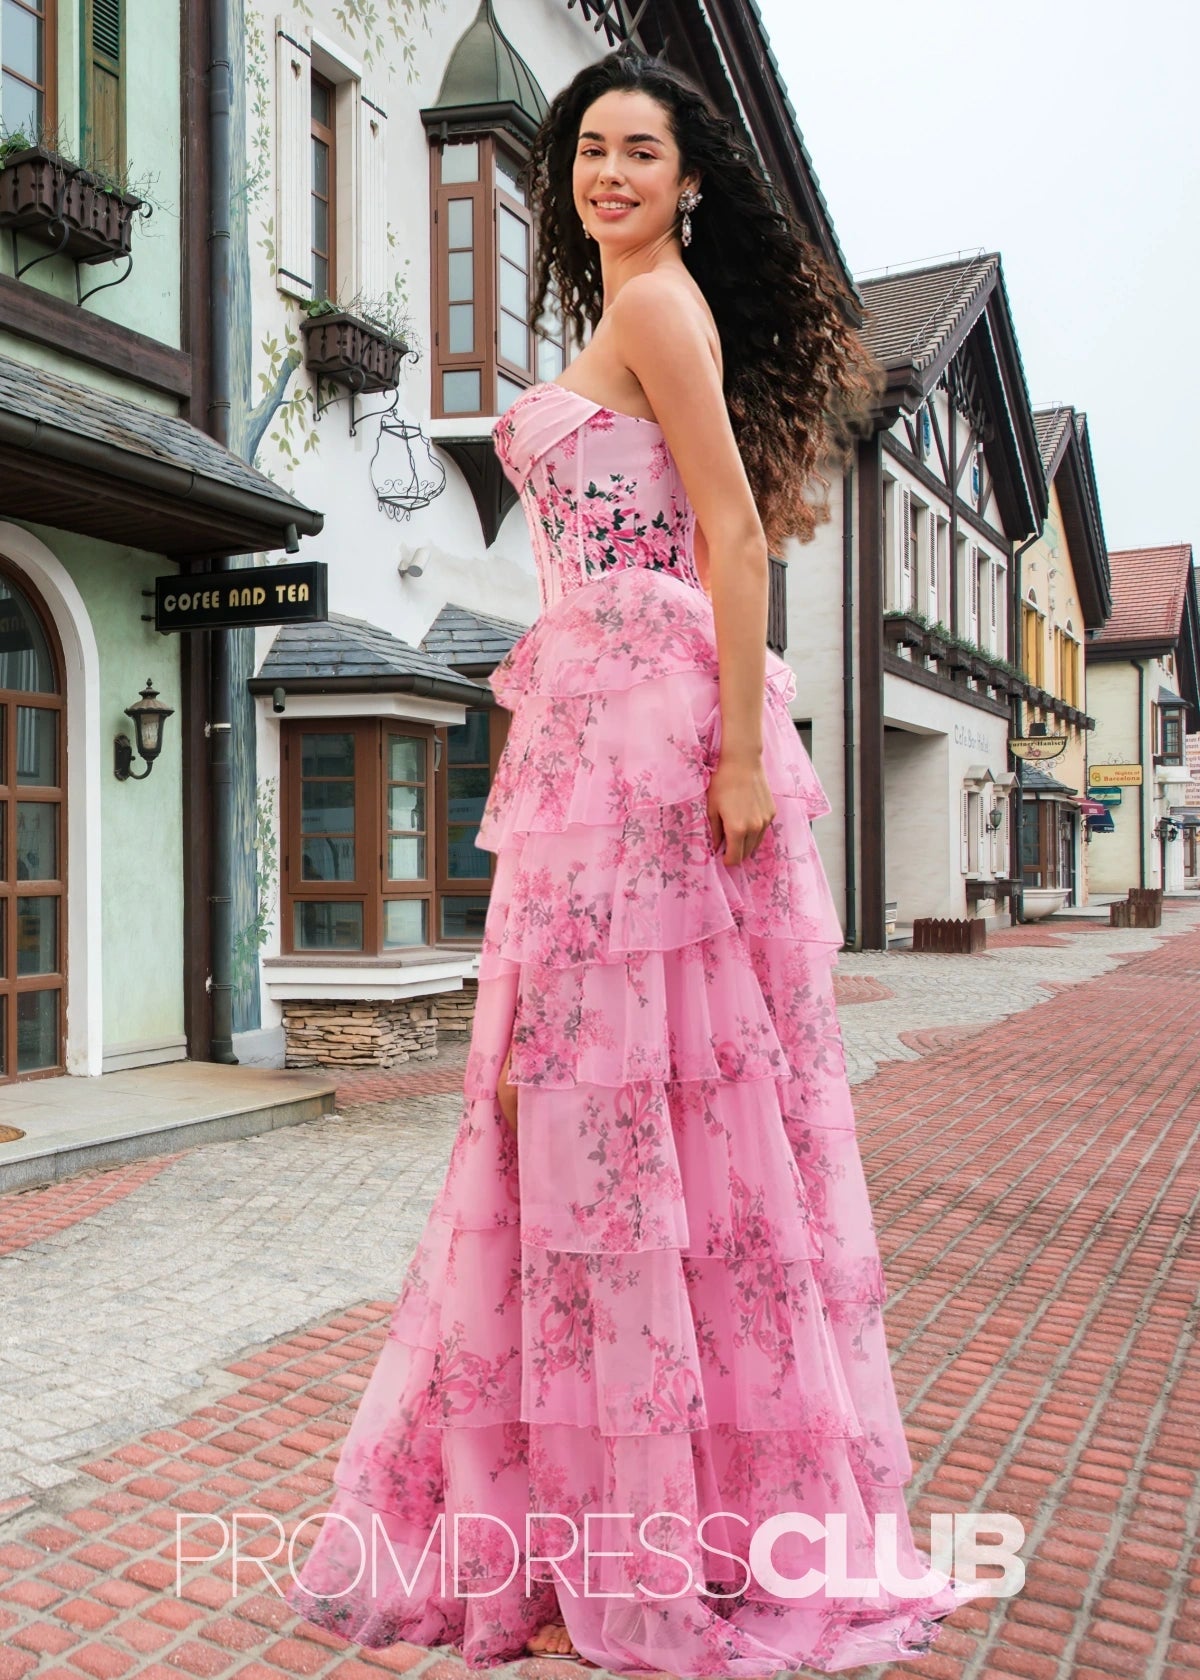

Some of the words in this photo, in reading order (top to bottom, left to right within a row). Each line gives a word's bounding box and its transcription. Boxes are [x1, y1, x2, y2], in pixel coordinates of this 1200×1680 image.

[164, 590, 220, 613] COFEE
[228, 587, 266, 607] AND
[275, 583, 309, 604] TEA
